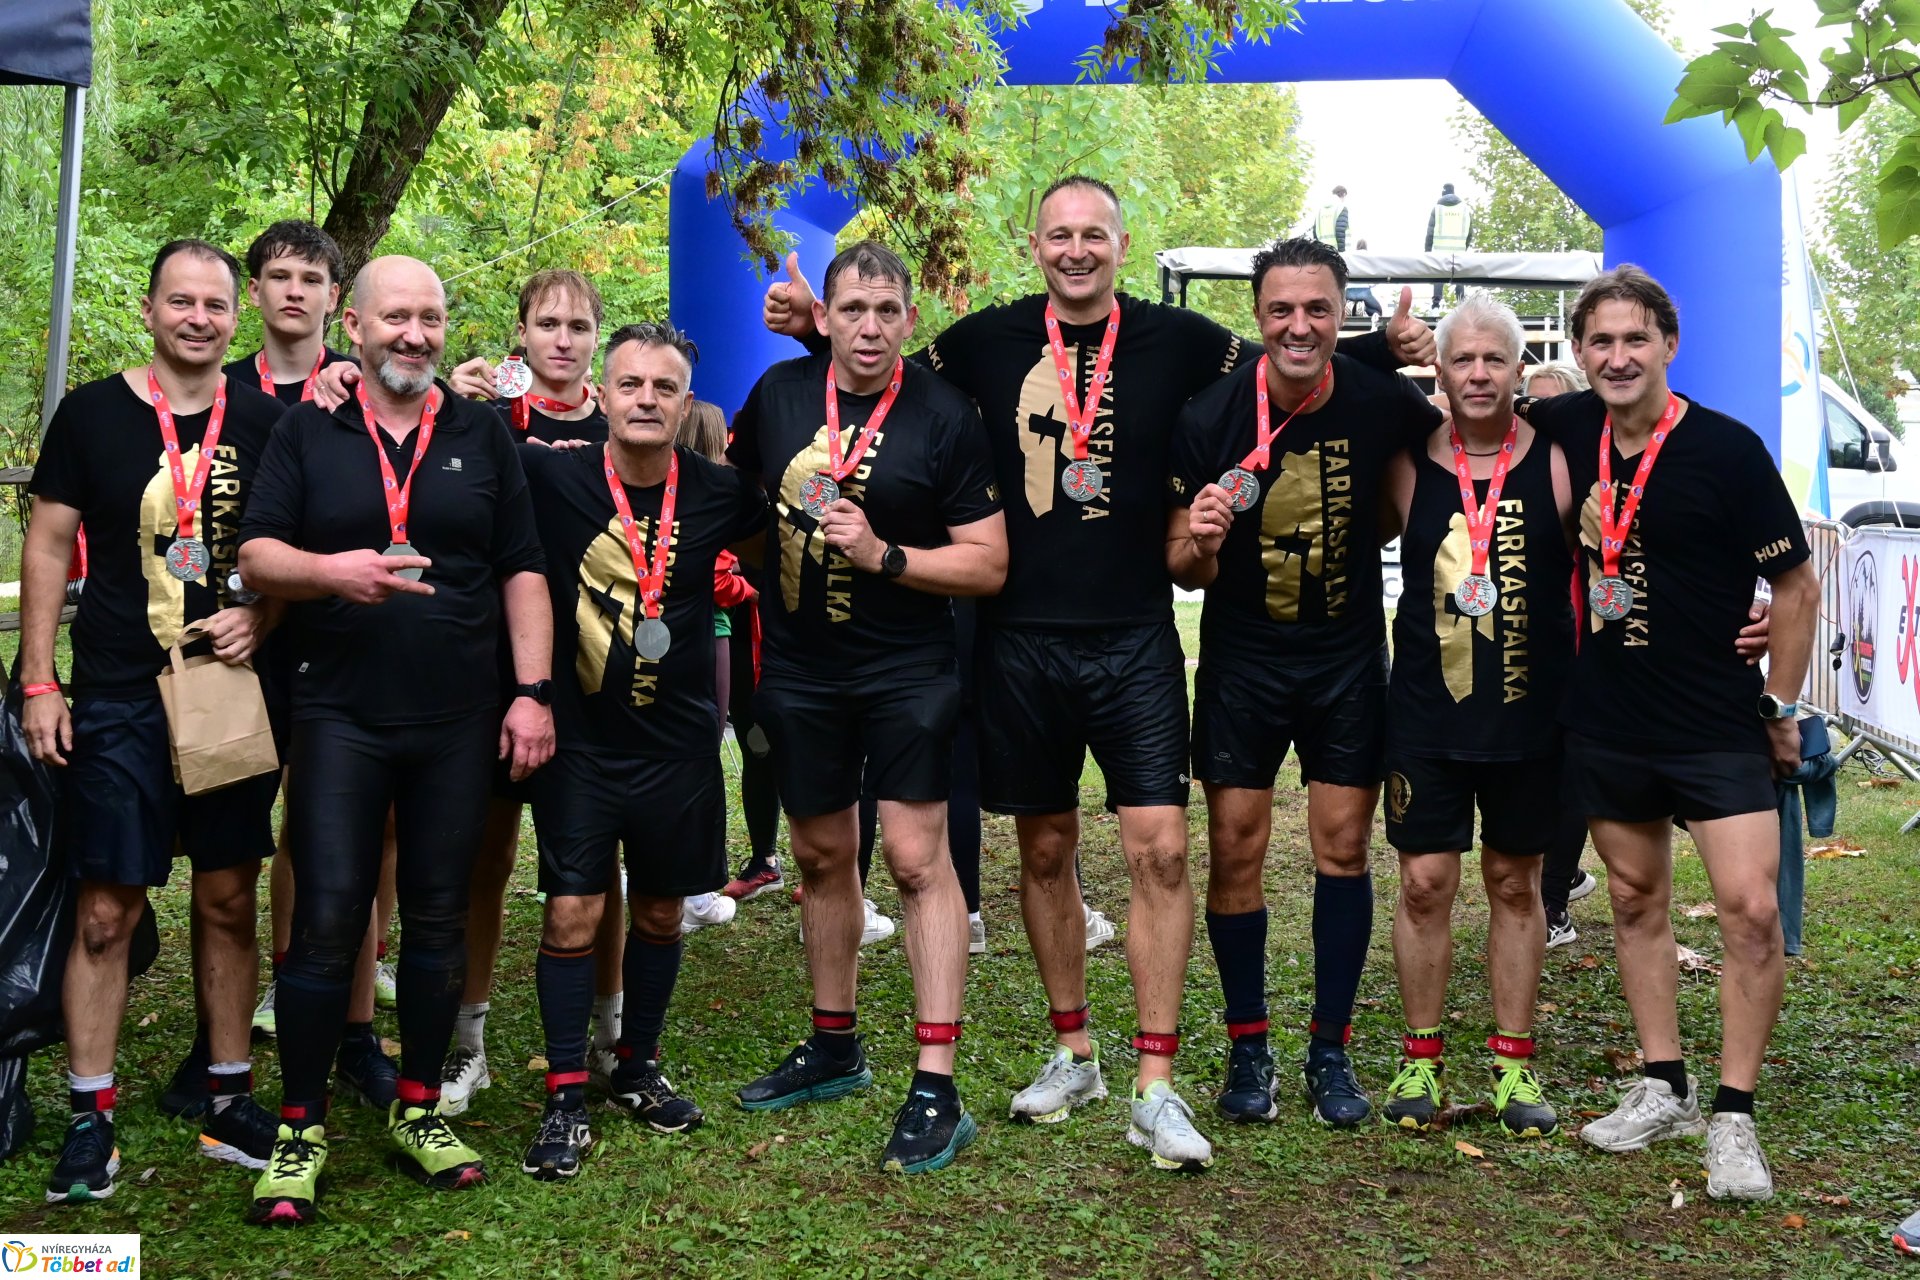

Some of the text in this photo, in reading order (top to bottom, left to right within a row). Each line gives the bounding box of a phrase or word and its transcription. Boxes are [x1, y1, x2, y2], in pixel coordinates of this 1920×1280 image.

[1220, 335, 1241, 373] HUN
[1754, 536, 1793, 563] HUN
[1495, 498, 1529, 704] FARKASFALKA
[918, 1027, 933, 1038] 973
[1497, 1040, 1513, 1051] 963
